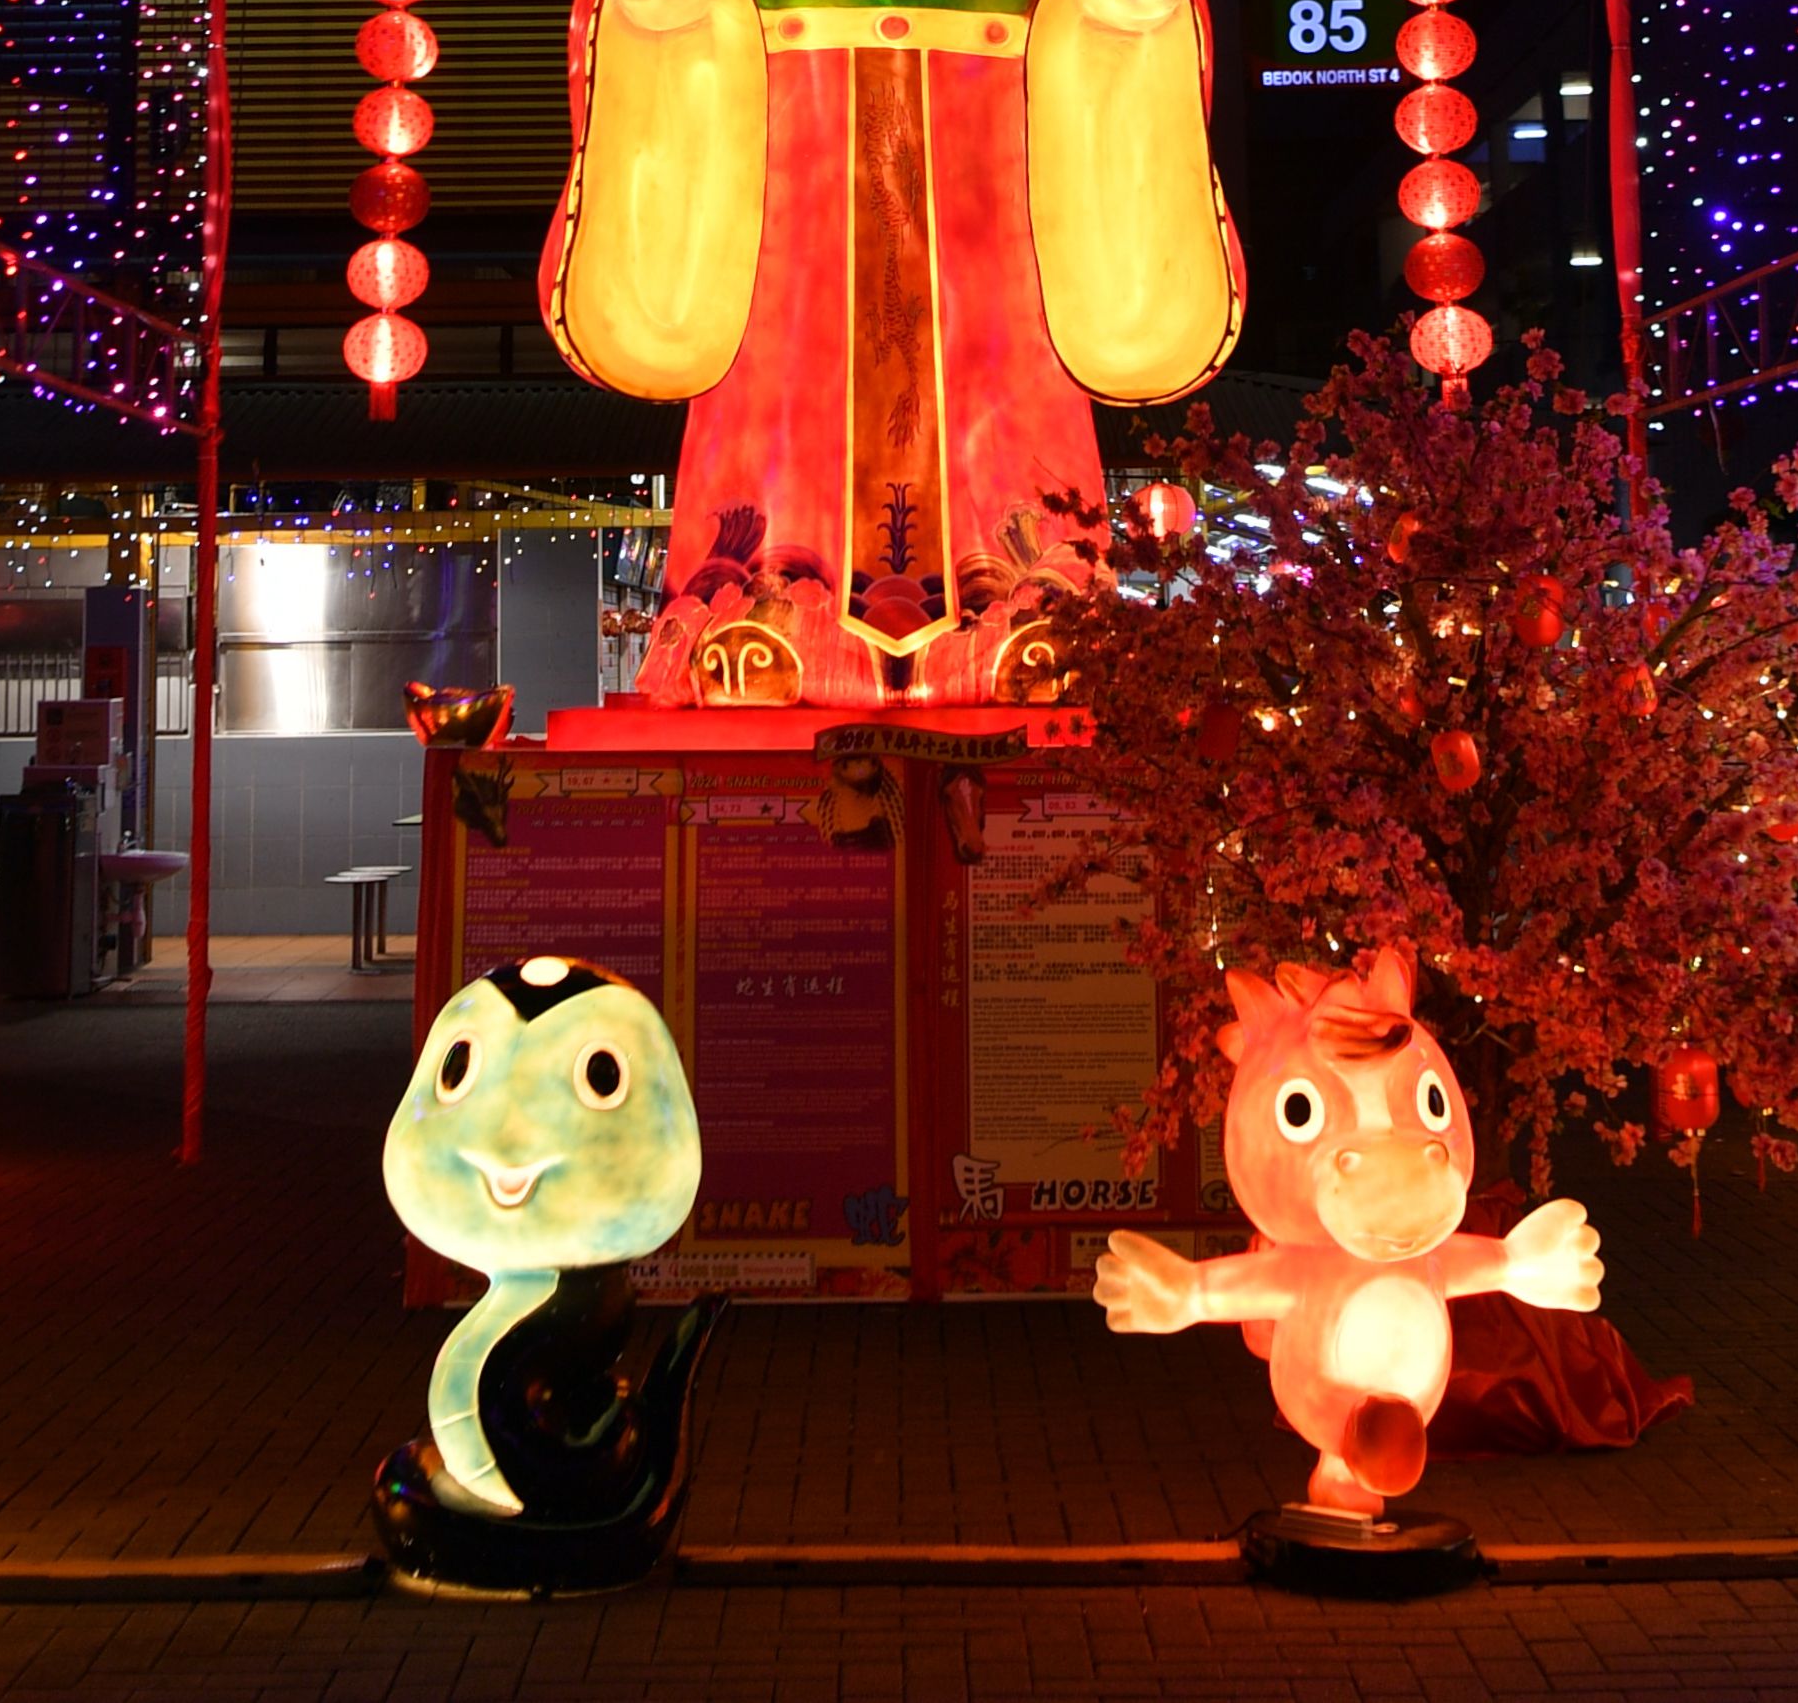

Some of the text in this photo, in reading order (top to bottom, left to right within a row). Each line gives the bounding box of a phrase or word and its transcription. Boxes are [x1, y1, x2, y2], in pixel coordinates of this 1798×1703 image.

[1289, 0, 1367, 53] 85
[1262, 68, 1400, 86] BEDOK NORTH ST 4
[726, 775, 771, 788] SNAKE
[1017, 774, 1043, 785] 2024
[952, 1154, 1006, 1221] 馬
[1031, 1178, 1160, 1211] HORSE
[699, 1198, 812, 1233] SNAKE
